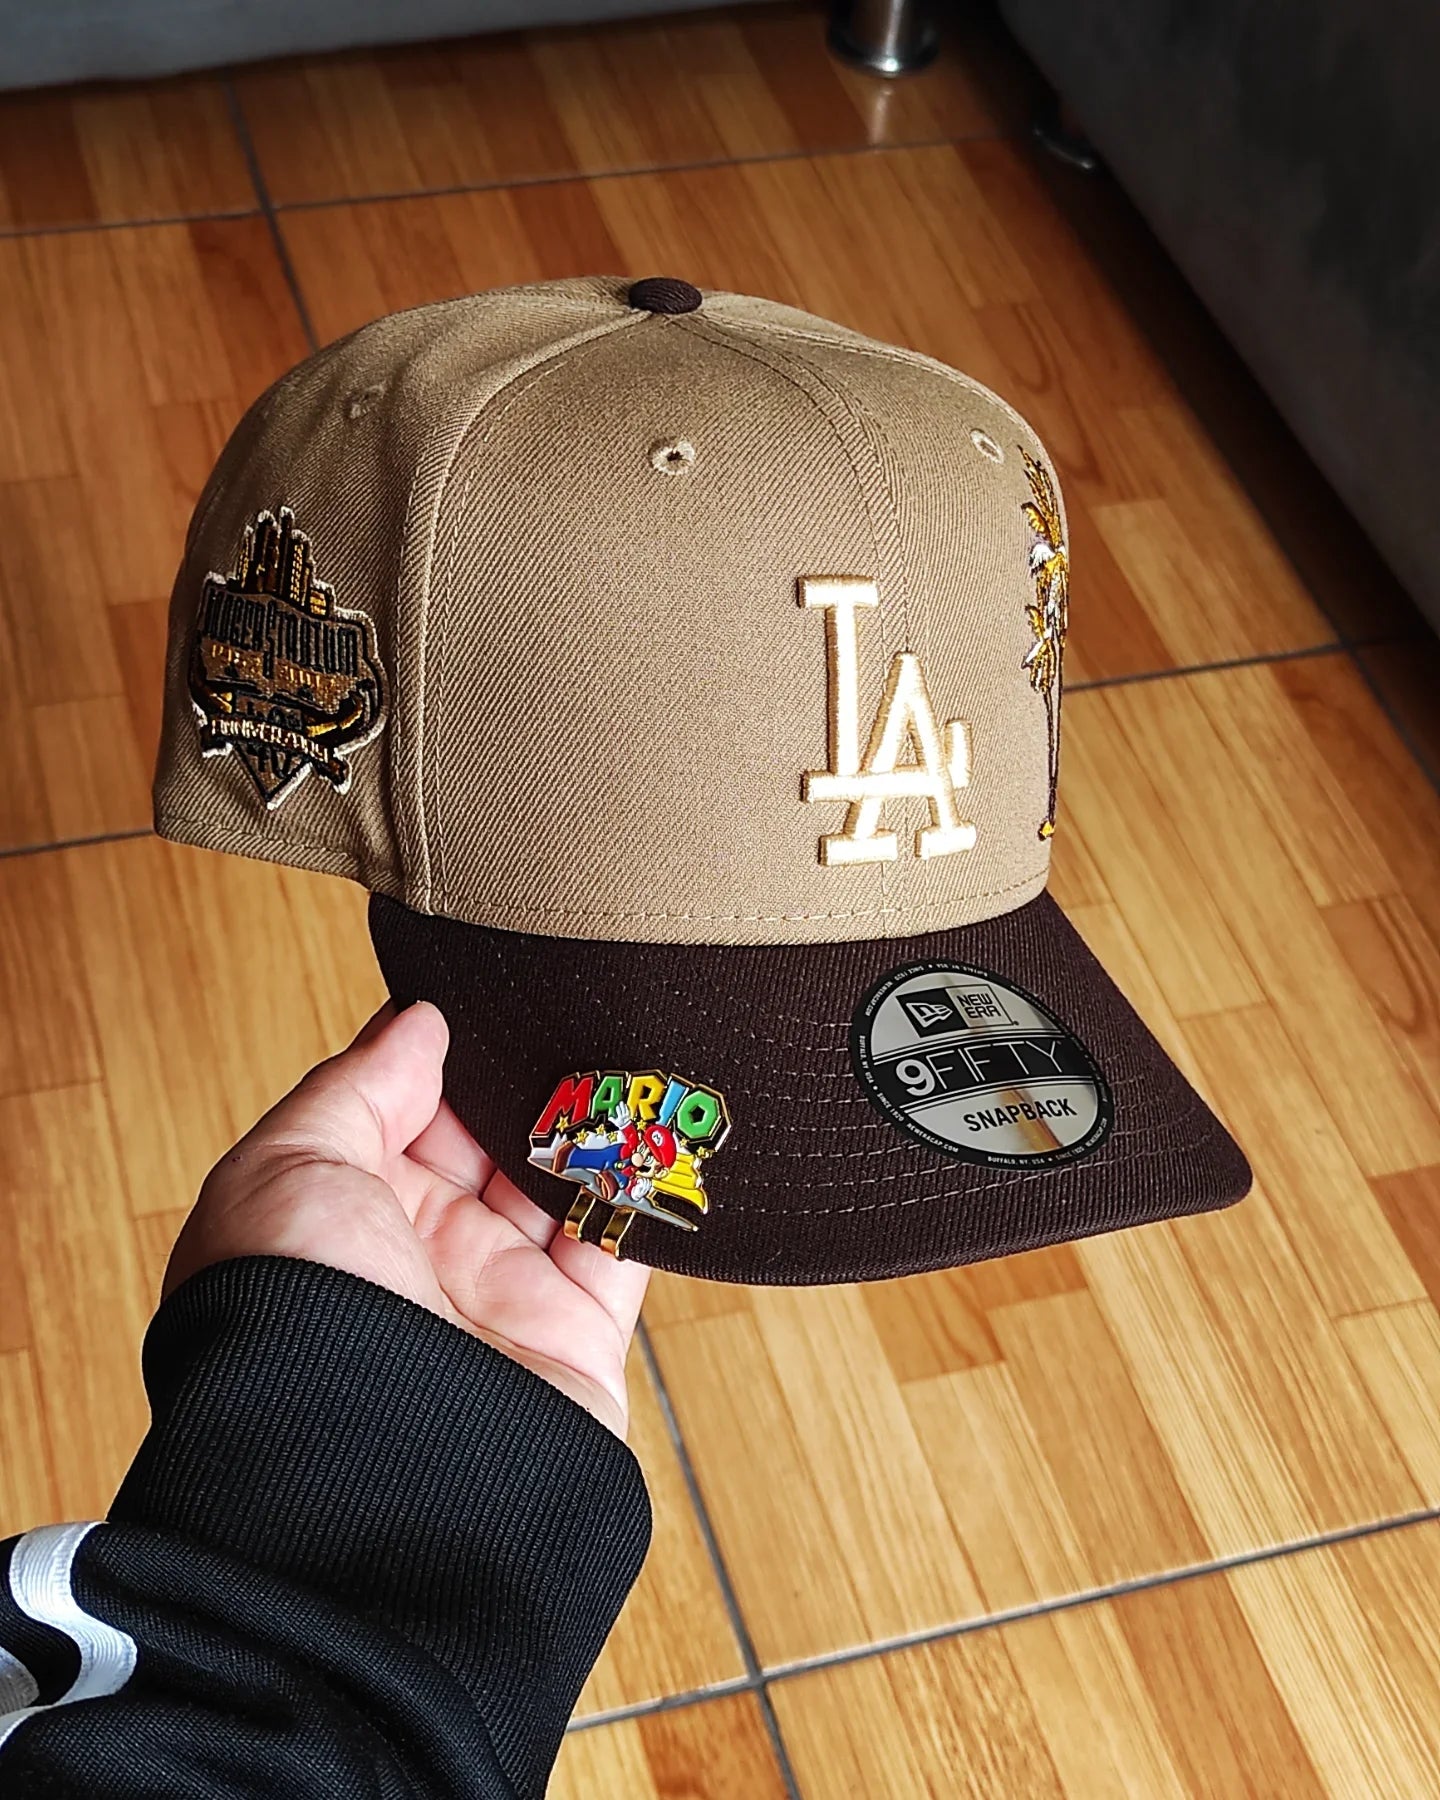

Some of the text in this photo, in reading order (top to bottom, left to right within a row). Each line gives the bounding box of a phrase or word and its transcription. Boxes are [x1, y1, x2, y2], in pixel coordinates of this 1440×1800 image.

[797, 574, 976, 866] LA
[956, 993, 993, 1008] NEW
[965, 1005, 1001, 1019] ERA
[895, 1041, 1063, 1097] 9FIFTY
[532, 1074, 723, 1141] MARIO
[963, 1098, 1077, 1132] SNAPBACK
